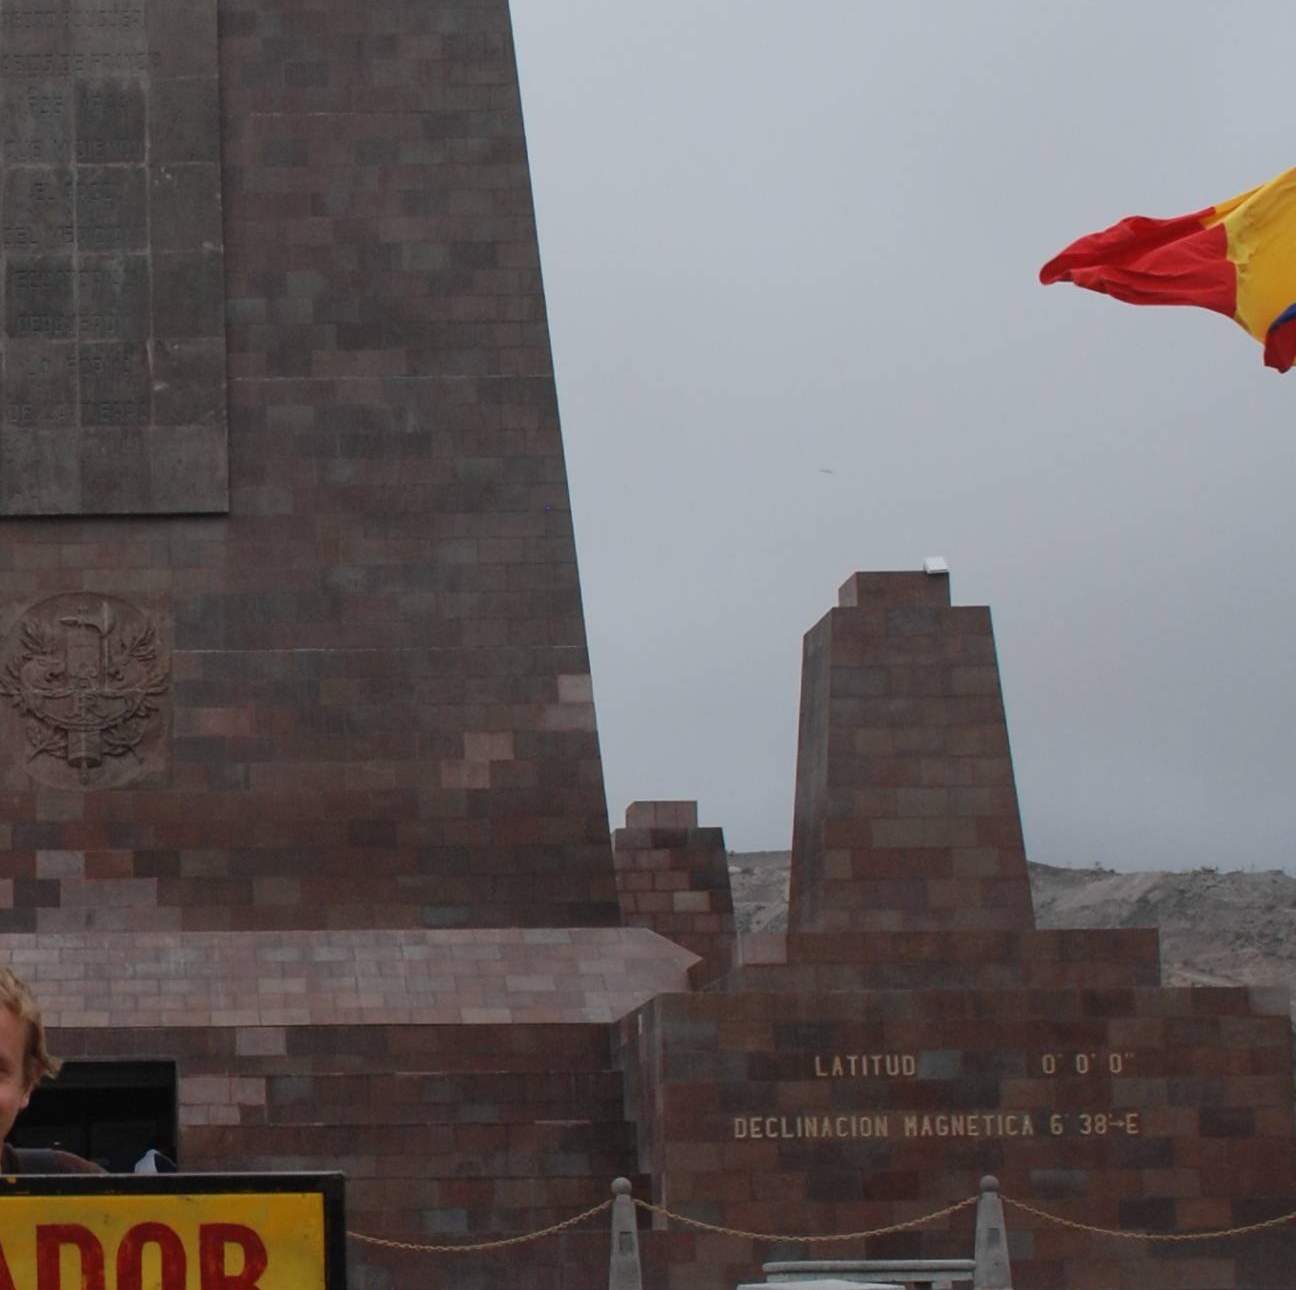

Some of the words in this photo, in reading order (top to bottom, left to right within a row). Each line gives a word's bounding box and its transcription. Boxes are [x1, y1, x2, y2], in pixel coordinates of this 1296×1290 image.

[814, 1054, 917, 1077] LATITUD
[734, 1115, 889, 1139] DECLINACION
[903, 1113, 1035, 1137] MAGNETICA
